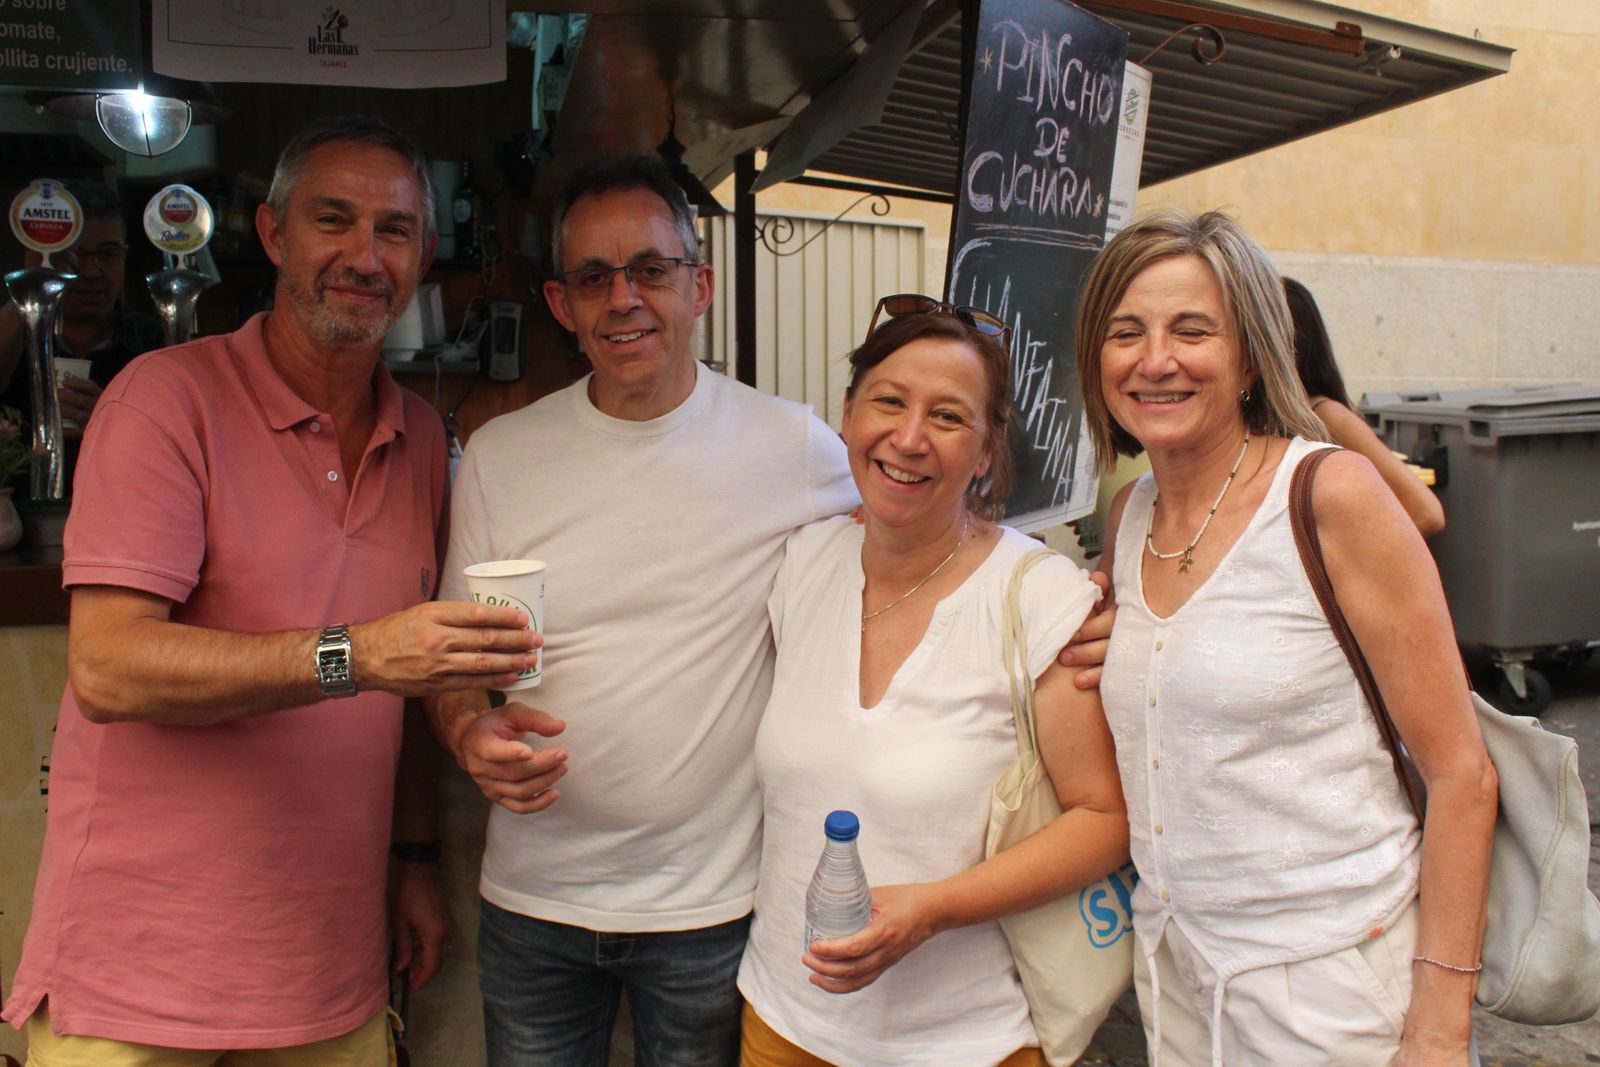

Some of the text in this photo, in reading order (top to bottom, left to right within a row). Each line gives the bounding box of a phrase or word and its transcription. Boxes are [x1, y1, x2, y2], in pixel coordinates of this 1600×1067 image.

[308, 36, 359, 55] Hermanas
[45, 52, 133, 75] crujiente.
[992, 18, 1113, 124] PINCHO
[1033, 117, 1070, 163] DE
[967, 150, 1092, 218] CUCHARA
[24, 208, 71, 220] AMSTEL
